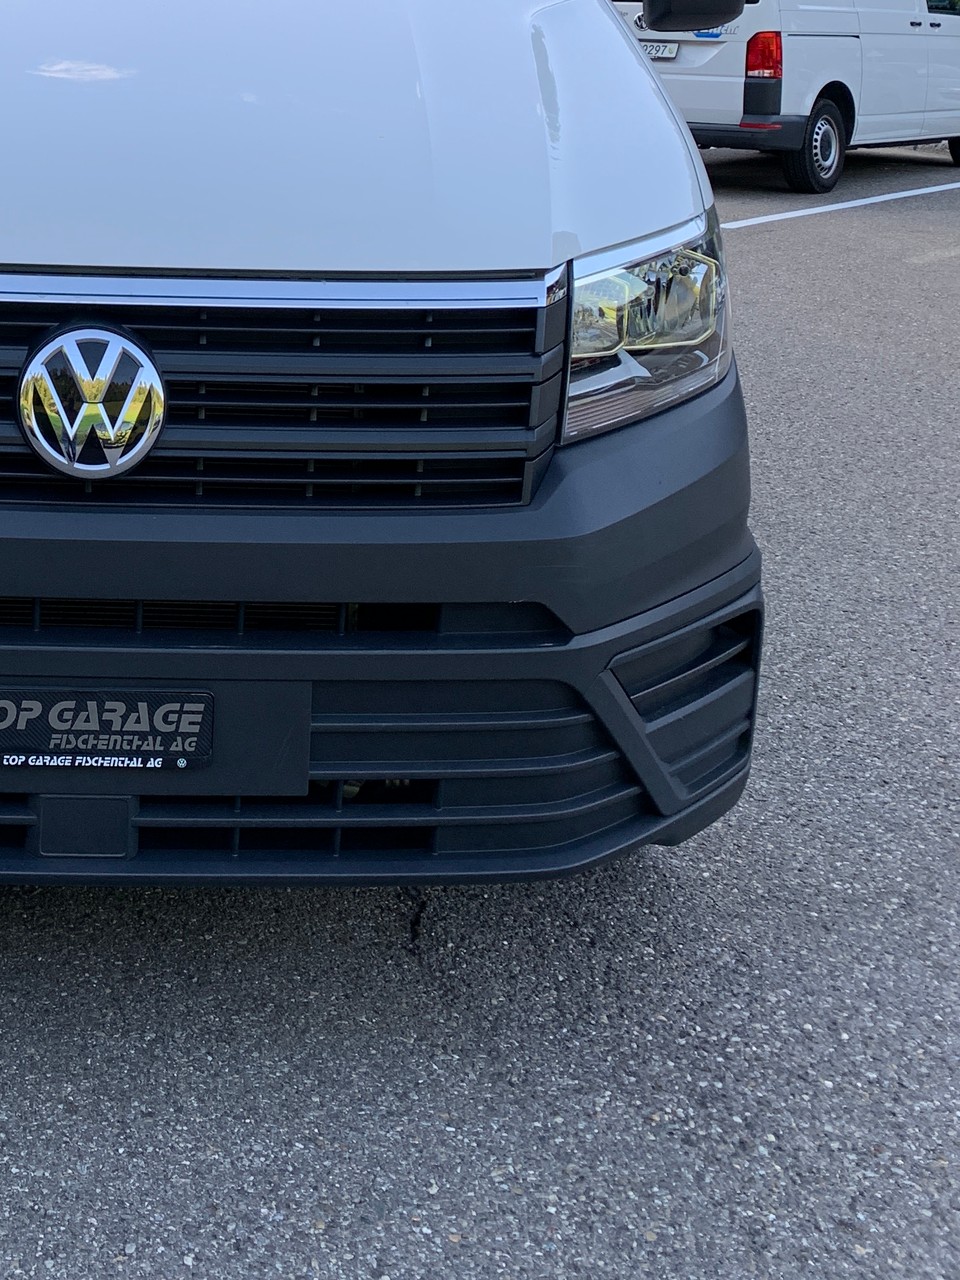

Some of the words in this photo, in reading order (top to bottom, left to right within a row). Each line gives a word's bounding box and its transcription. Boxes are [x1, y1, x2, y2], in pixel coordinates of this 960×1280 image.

[48, 700, 205, 733] GARAGE
[49, 733, 164, 751] FISCHENTHAL
[169, 736, 197, 752] AG
[3, 755, 26, 766] TOP
[28, 755, 72, 767] GARAGE
[74, 756, 144, 768] FISCHENTHAL
[145, 757, 163, 768] AG
